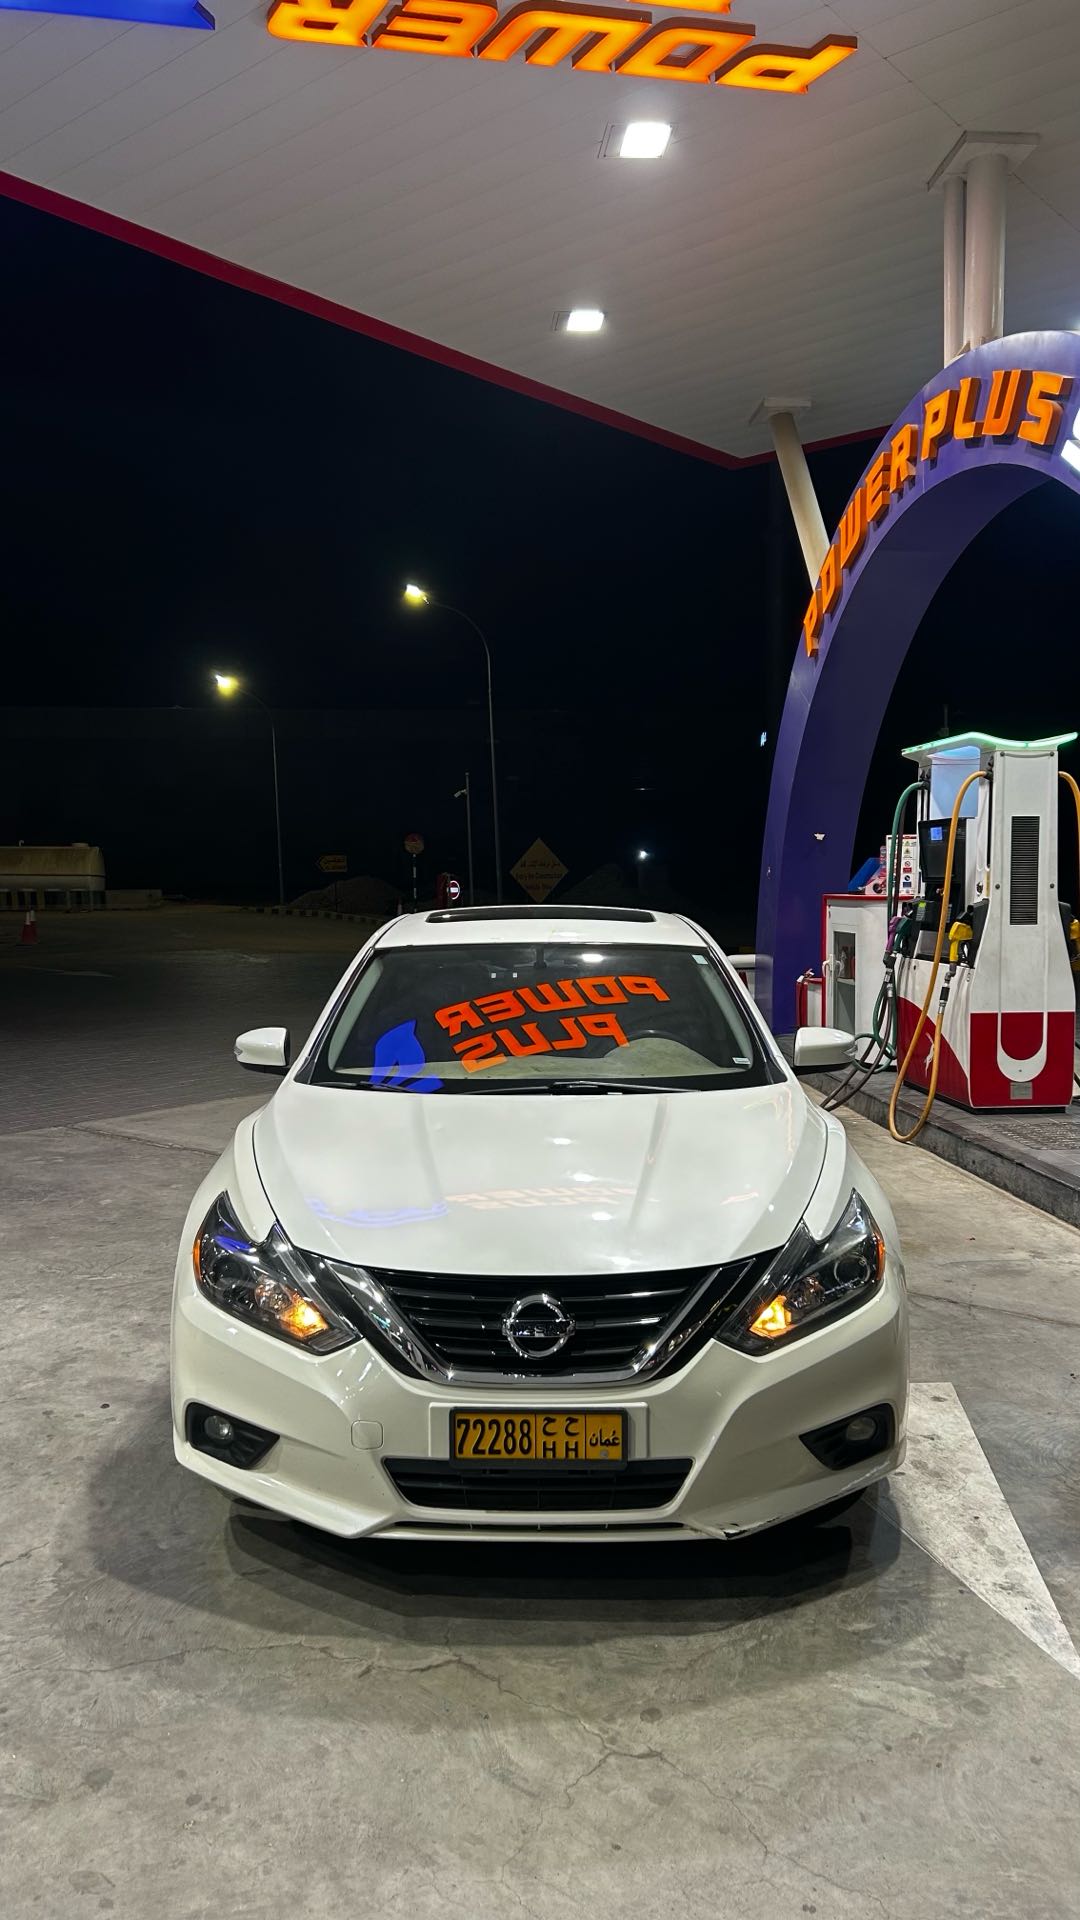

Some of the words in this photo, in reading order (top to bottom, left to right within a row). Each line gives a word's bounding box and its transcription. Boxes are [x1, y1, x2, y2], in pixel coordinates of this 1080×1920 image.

[266, 0, 858, 95] POWER
[803, 422, 918, 658] POWER
[920, 368, 1073, 461] PLUS
[456, 1418, 532, 1456] 72288
